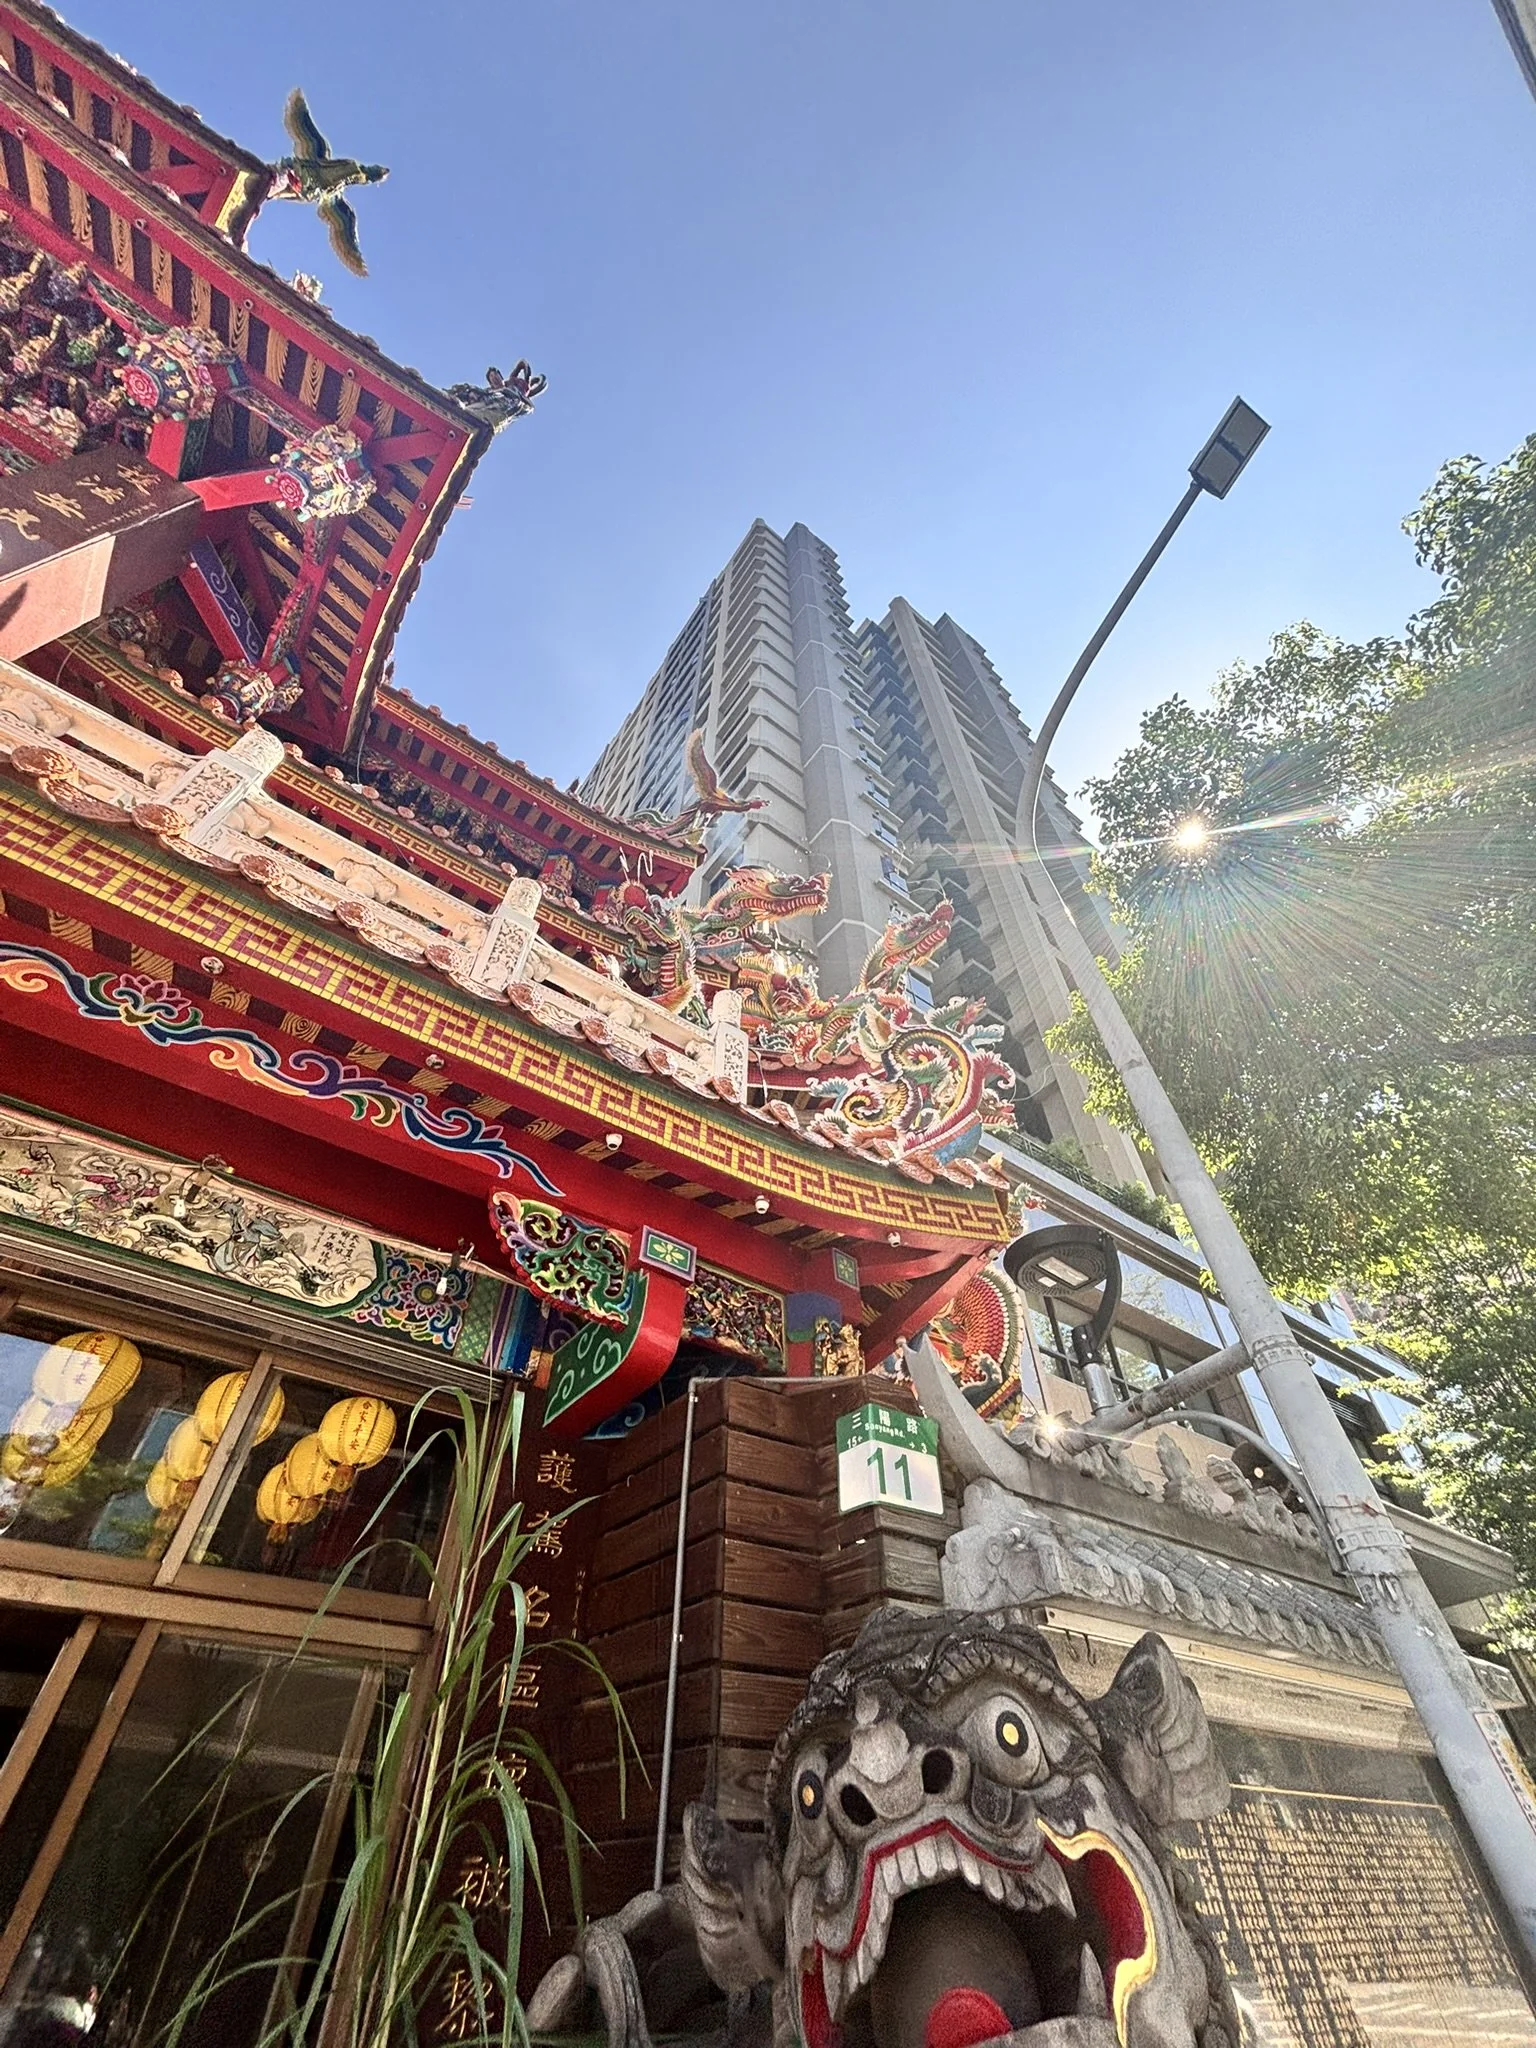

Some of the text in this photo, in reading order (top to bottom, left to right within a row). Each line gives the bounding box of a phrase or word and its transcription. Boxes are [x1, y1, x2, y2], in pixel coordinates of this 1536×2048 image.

[852, 1409, 920, 1435] 三陽路
[847, 1436, 857, 1448] 15
[921, 1442, 928, 1454] 3
[867, 1447, 912, 1501] 11
